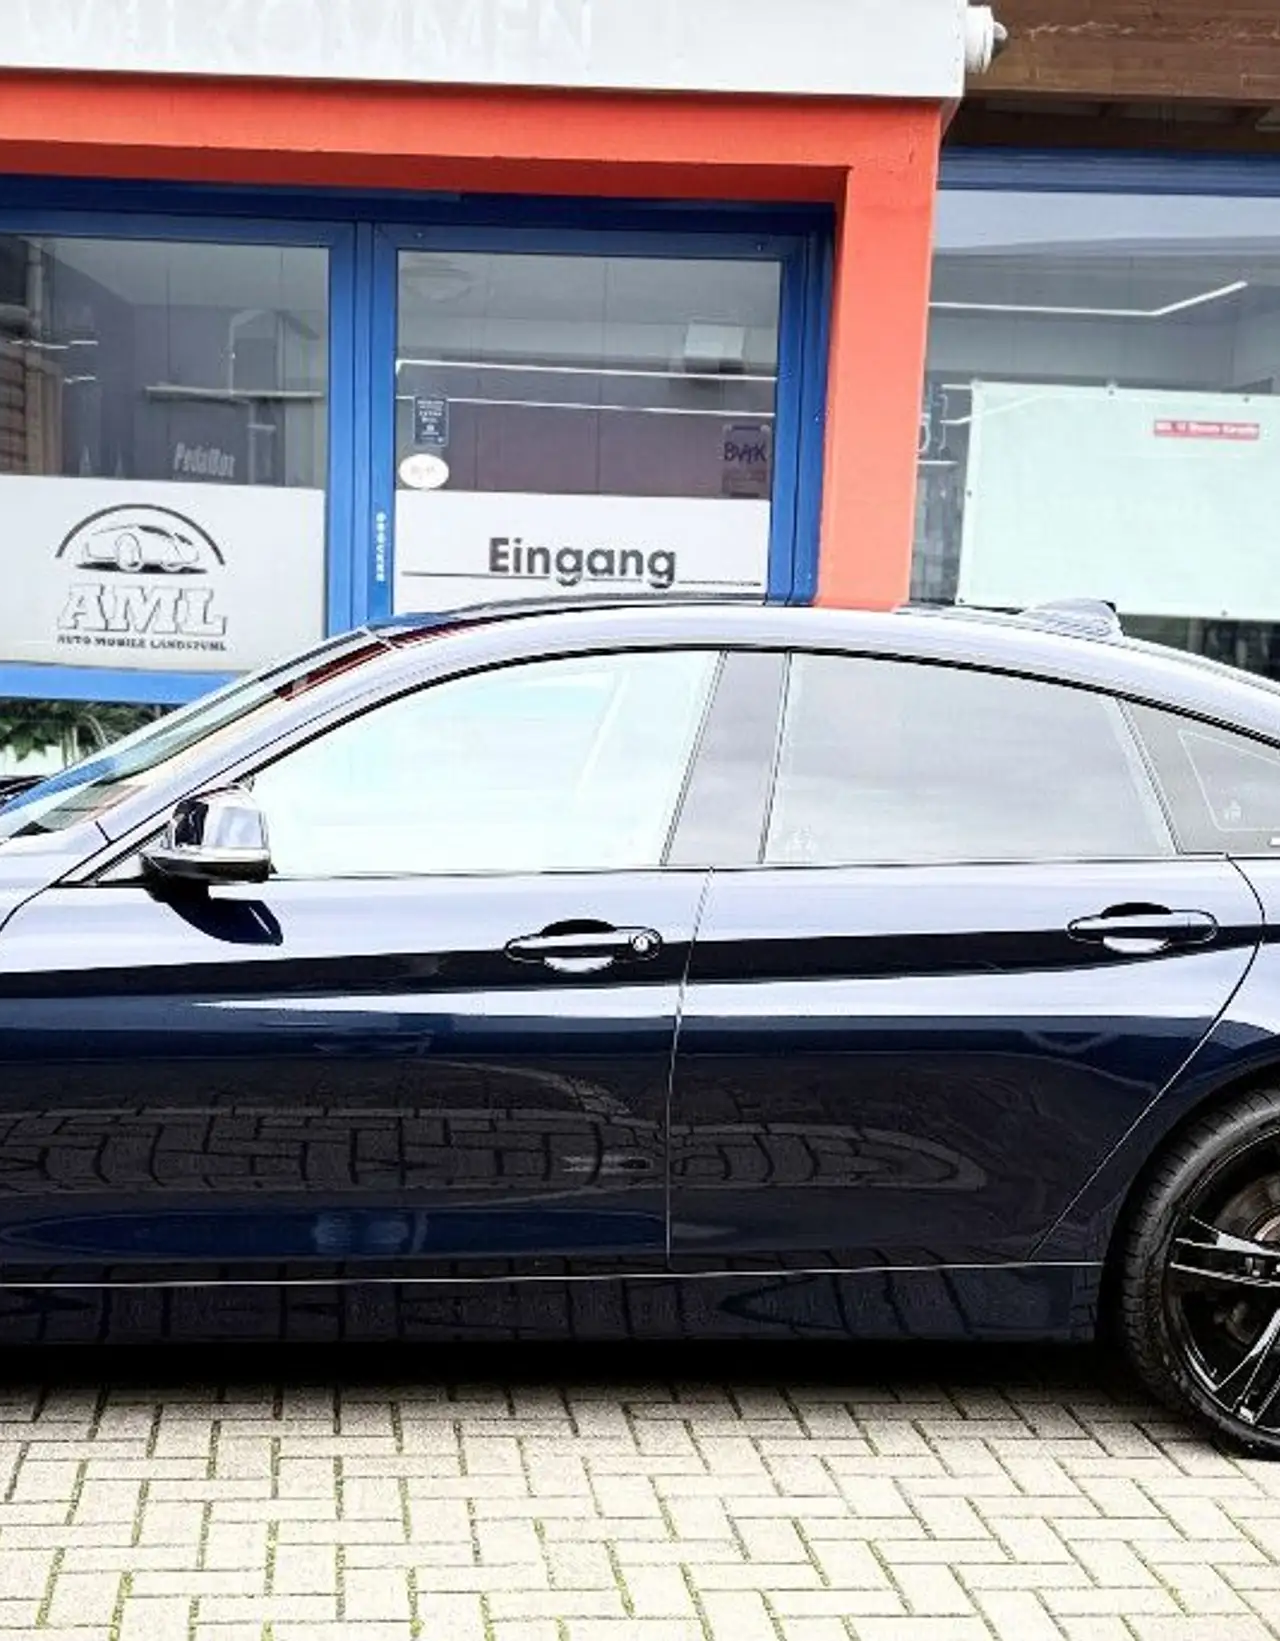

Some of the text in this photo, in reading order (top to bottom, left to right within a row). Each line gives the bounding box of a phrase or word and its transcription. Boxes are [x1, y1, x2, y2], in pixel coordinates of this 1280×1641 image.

[488, 537, 677, 589] Eingang
[56, 582, 228, 636] AML
[56, 635, 92, 645] AUTO
